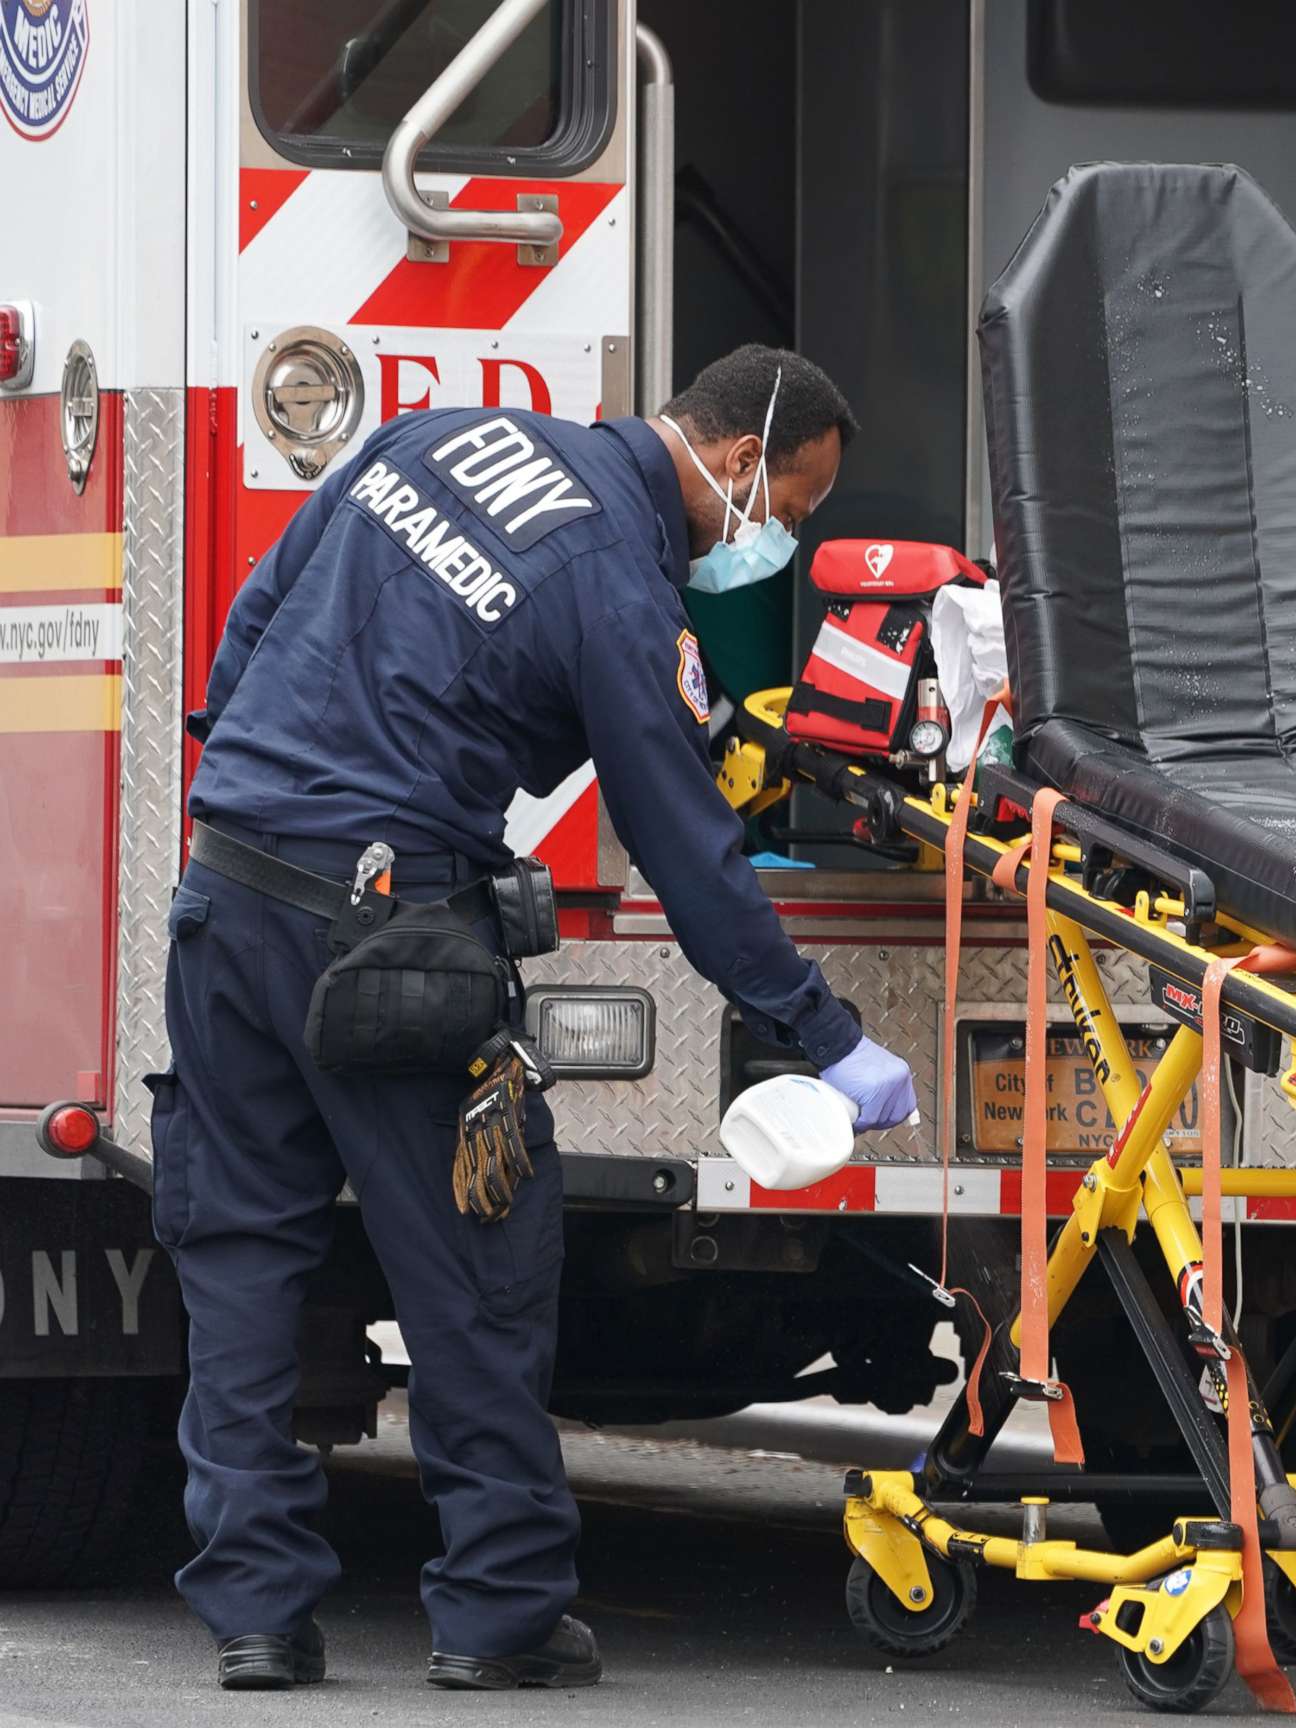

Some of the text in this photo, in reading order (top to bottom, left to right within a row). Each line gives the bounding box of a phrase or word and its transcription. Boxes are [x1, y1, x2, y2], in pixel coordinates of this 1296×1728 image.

[13, 3, 62, 70] MEDIC
[431, 416, 593, 535] FDNY
[350, 461, 517, 623] PARAMEDIC
[983, 1101, 1024, 1122] New
[0, 1249, 156, 1336] NY
